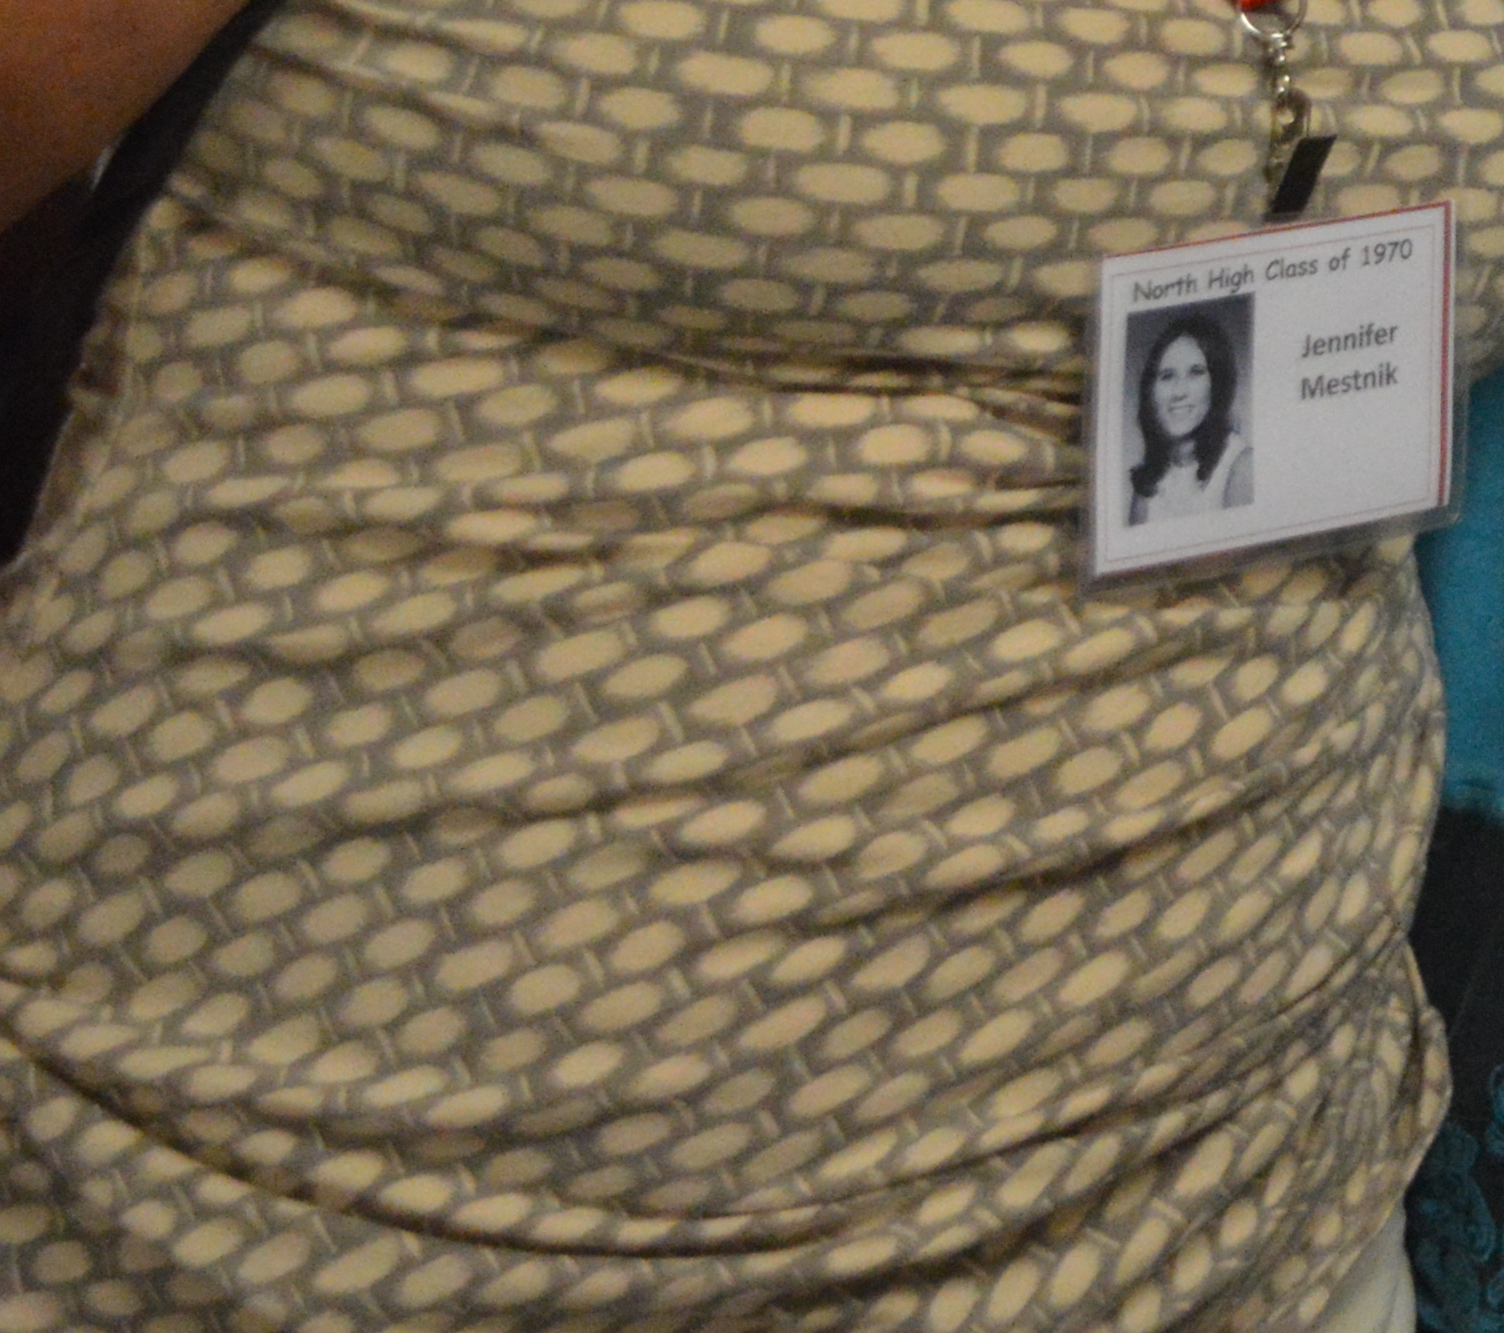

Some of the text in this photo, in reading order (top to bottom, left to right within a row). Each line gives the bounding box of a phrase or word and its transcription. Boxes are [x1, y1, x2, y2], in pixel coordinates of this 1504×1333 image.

[1132, 238, 1412, 303] North High Class of 1970
[1301, 322, 1398, 358] Jennifer
[1300, 361, 1398, 400] Mestnik
